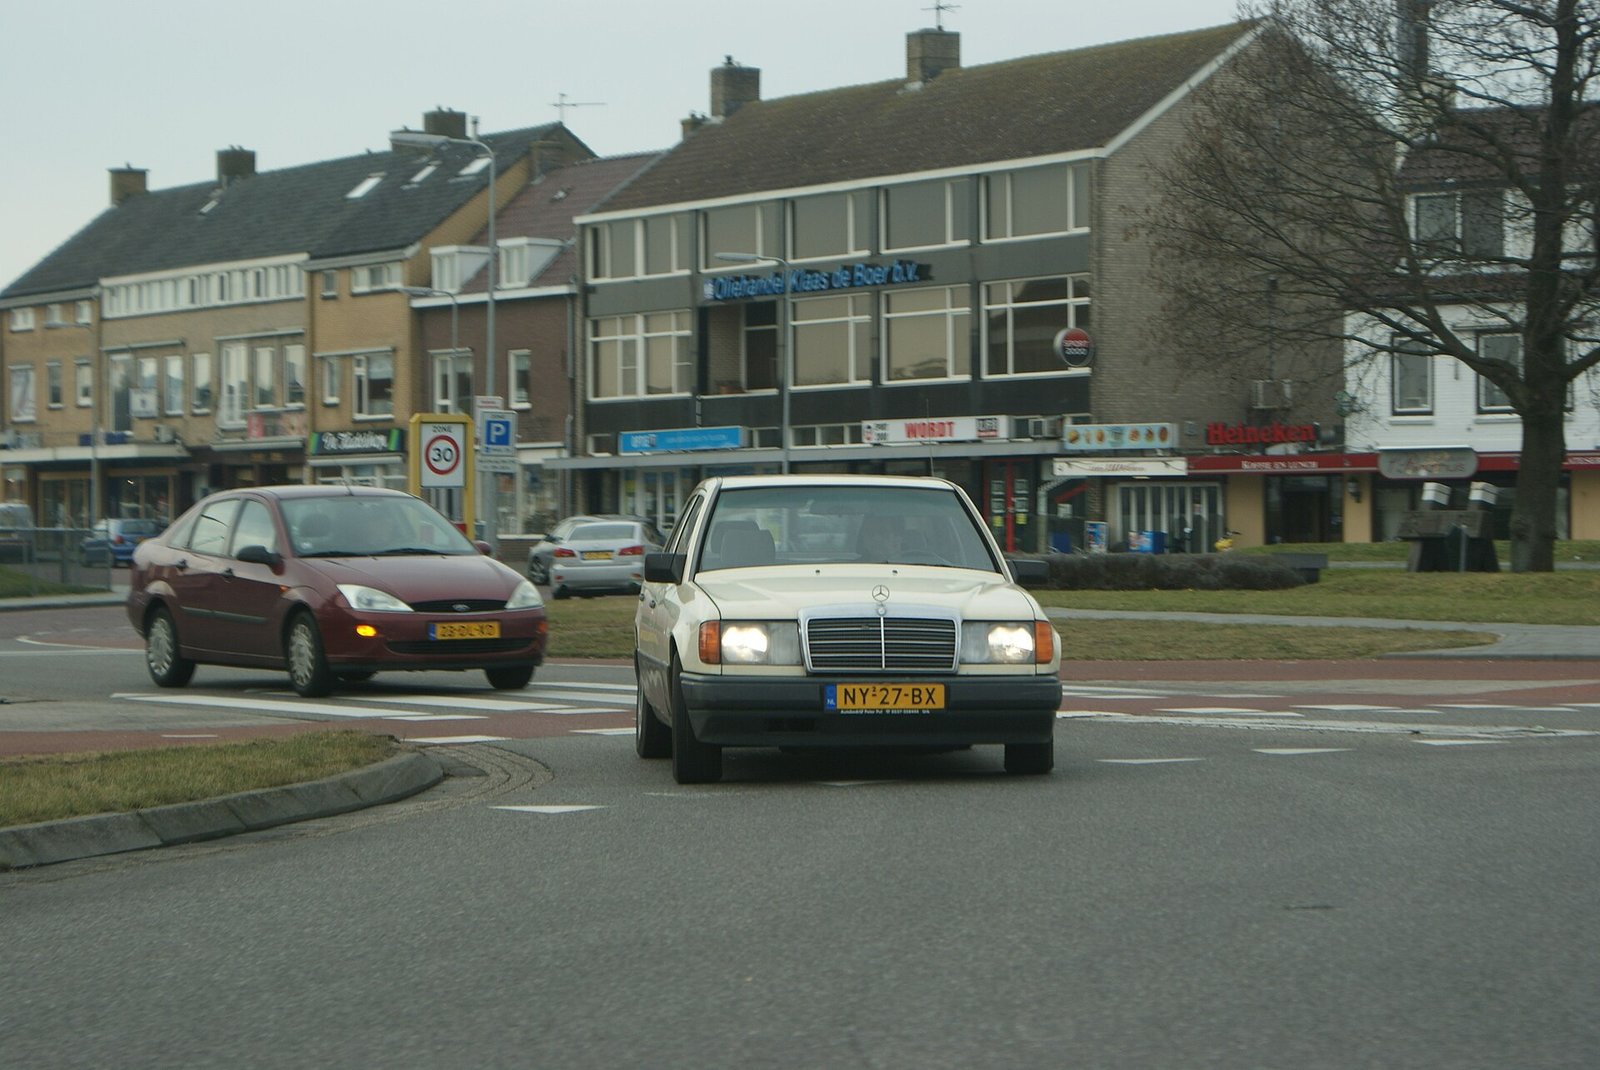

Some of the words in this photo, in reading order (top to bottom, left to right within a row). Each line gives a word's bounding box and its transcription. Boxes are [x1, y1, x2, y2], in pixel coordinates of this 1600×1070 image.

[791, 268, 828, 293] Klaas
[832, 267, 851, 289] de
[853, 263, 889, 287] Boer
[1063, 340, 1089, 348] SPORT
[1064, 347, 1088, 356] 2000
[432, 425, 453, 433] ZONE
[489, 422, 506, 443] P
[904, 421, 955, 439] WORDT
[1206, 421, 1316, 445] Heineken
[431, 447, 454, 462] 30
